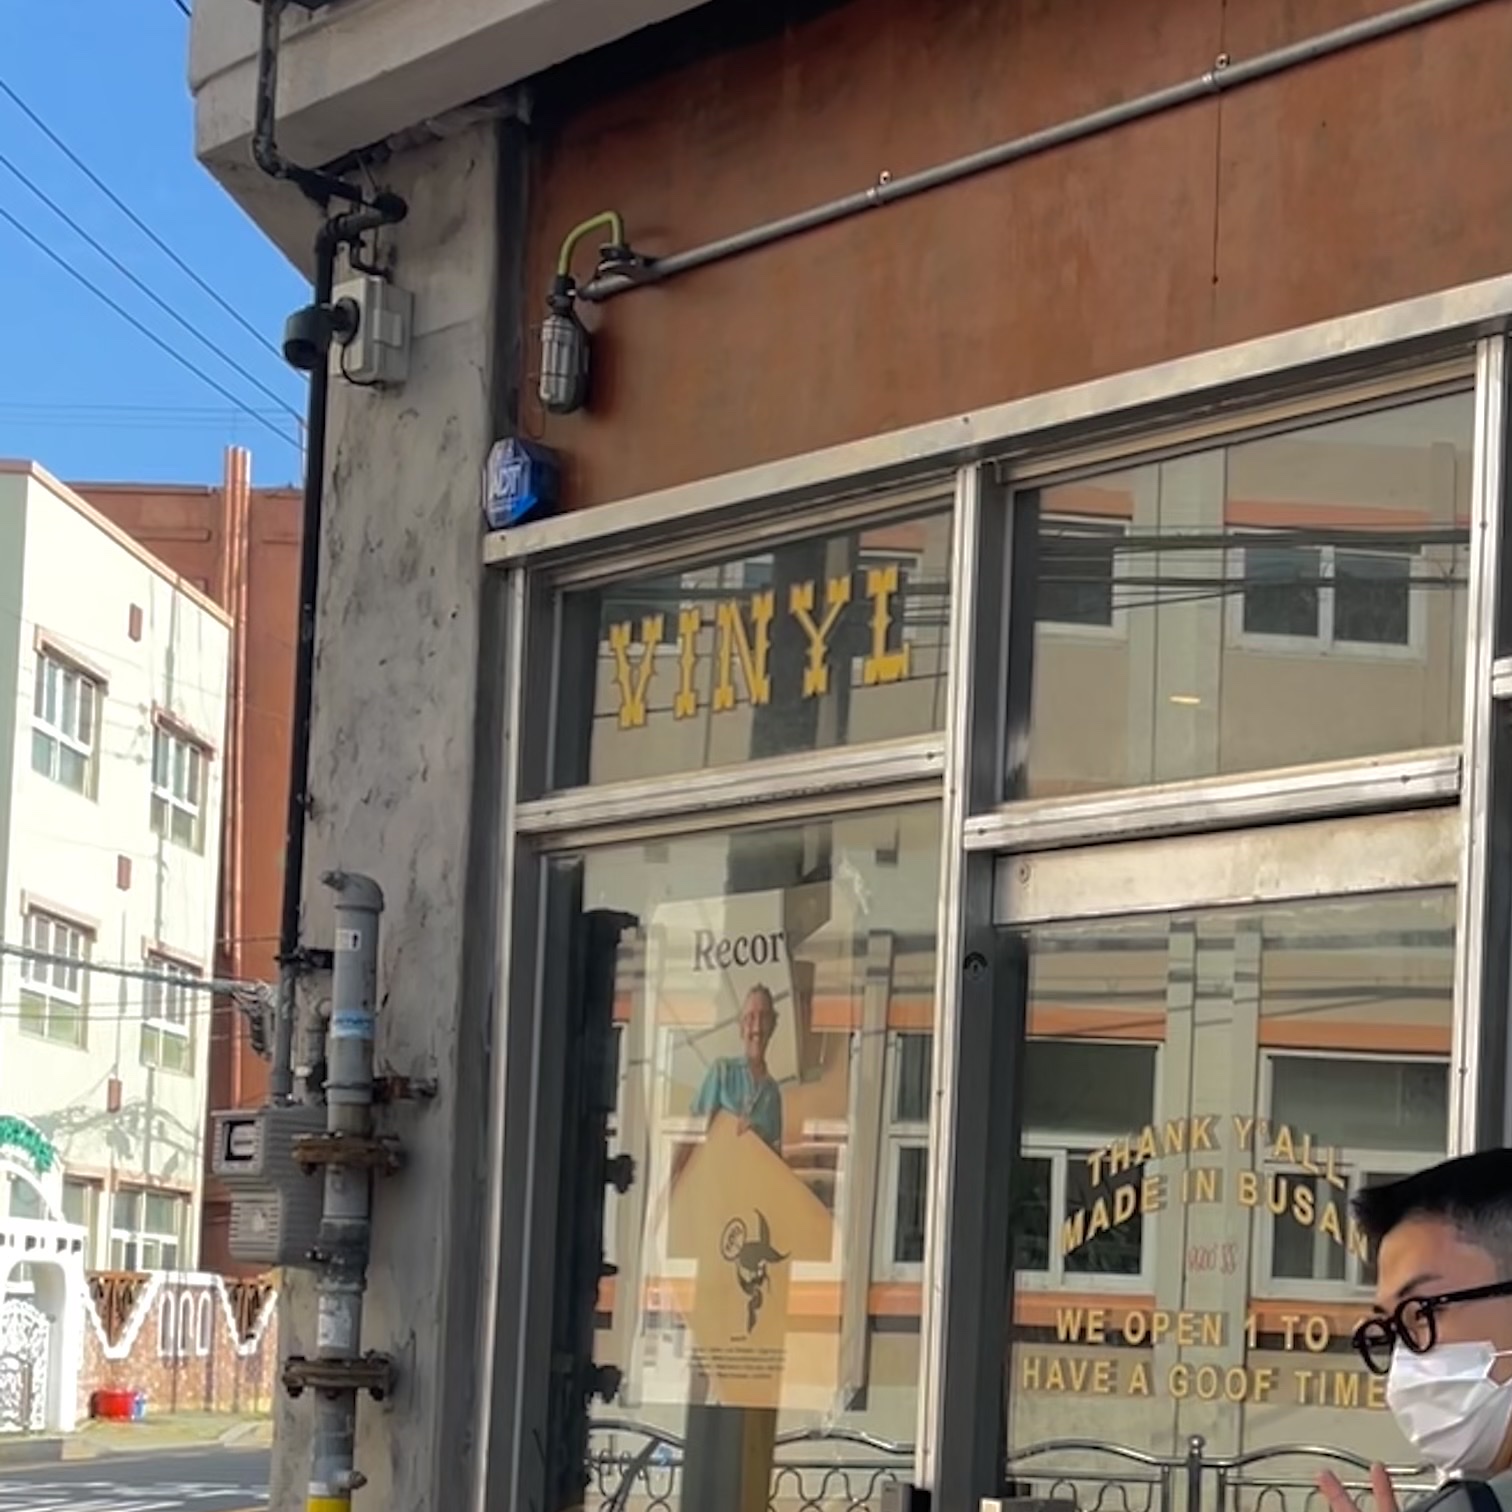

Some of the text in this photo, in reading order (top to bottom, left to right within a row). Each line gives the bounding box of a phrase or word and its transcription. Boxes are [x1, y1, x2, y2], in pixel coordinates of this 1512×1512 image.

[609, 565, 911, 729] VINYL
[1087, 1115, 1346, 1190] THANK Y'ALL
[1060, 1168, 1369, 1263] MADE IN BUSAN
[1056, 1308, 1106, 1343] WE
[1123, 1310, 1223, 1347] OPEN
[1281, 1315, 1330, 1352] TO
[1021, 1357, 1388, 1409] HAVE A GOOF TIME
